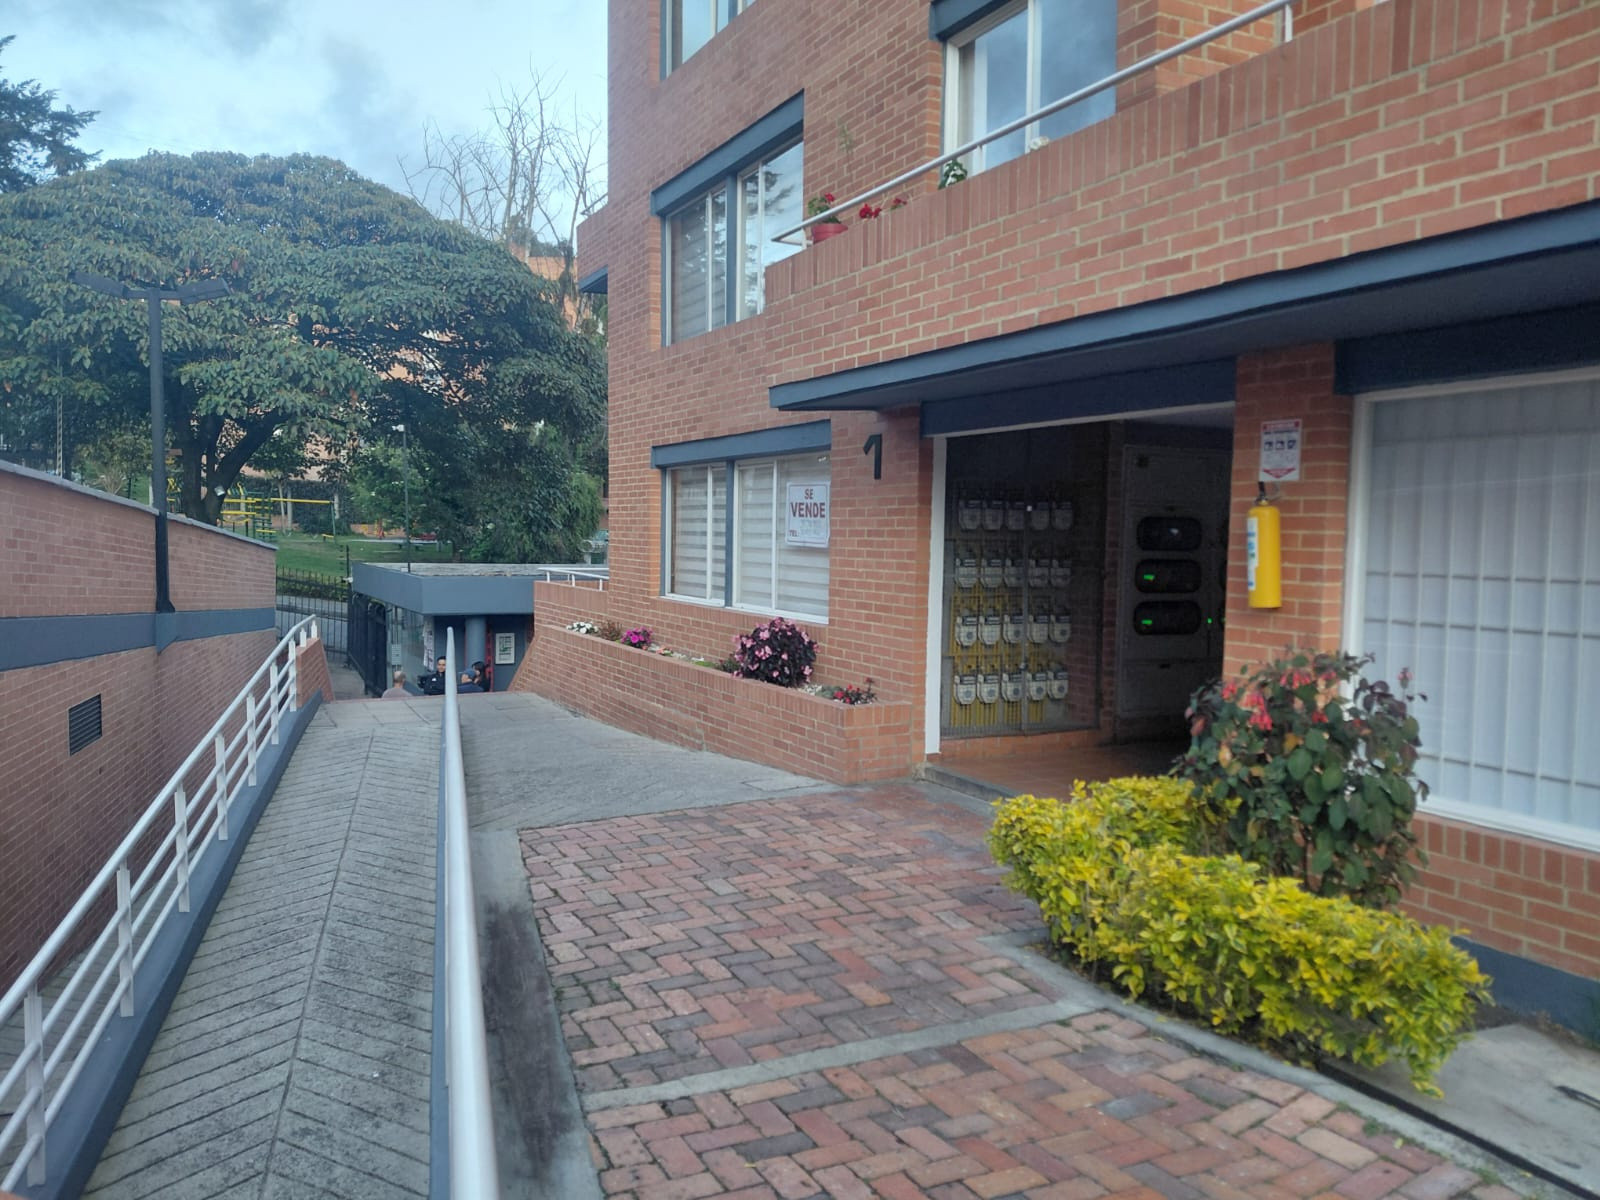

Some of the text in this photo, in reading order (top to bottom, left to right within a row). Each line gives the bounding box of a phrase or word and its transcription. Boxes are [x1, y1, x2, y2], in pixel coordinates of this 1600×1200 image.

[863, 433, 882, 480] 1
[804, 488, 814, 500] SE
[790, 502, 826, 518] VENDE
